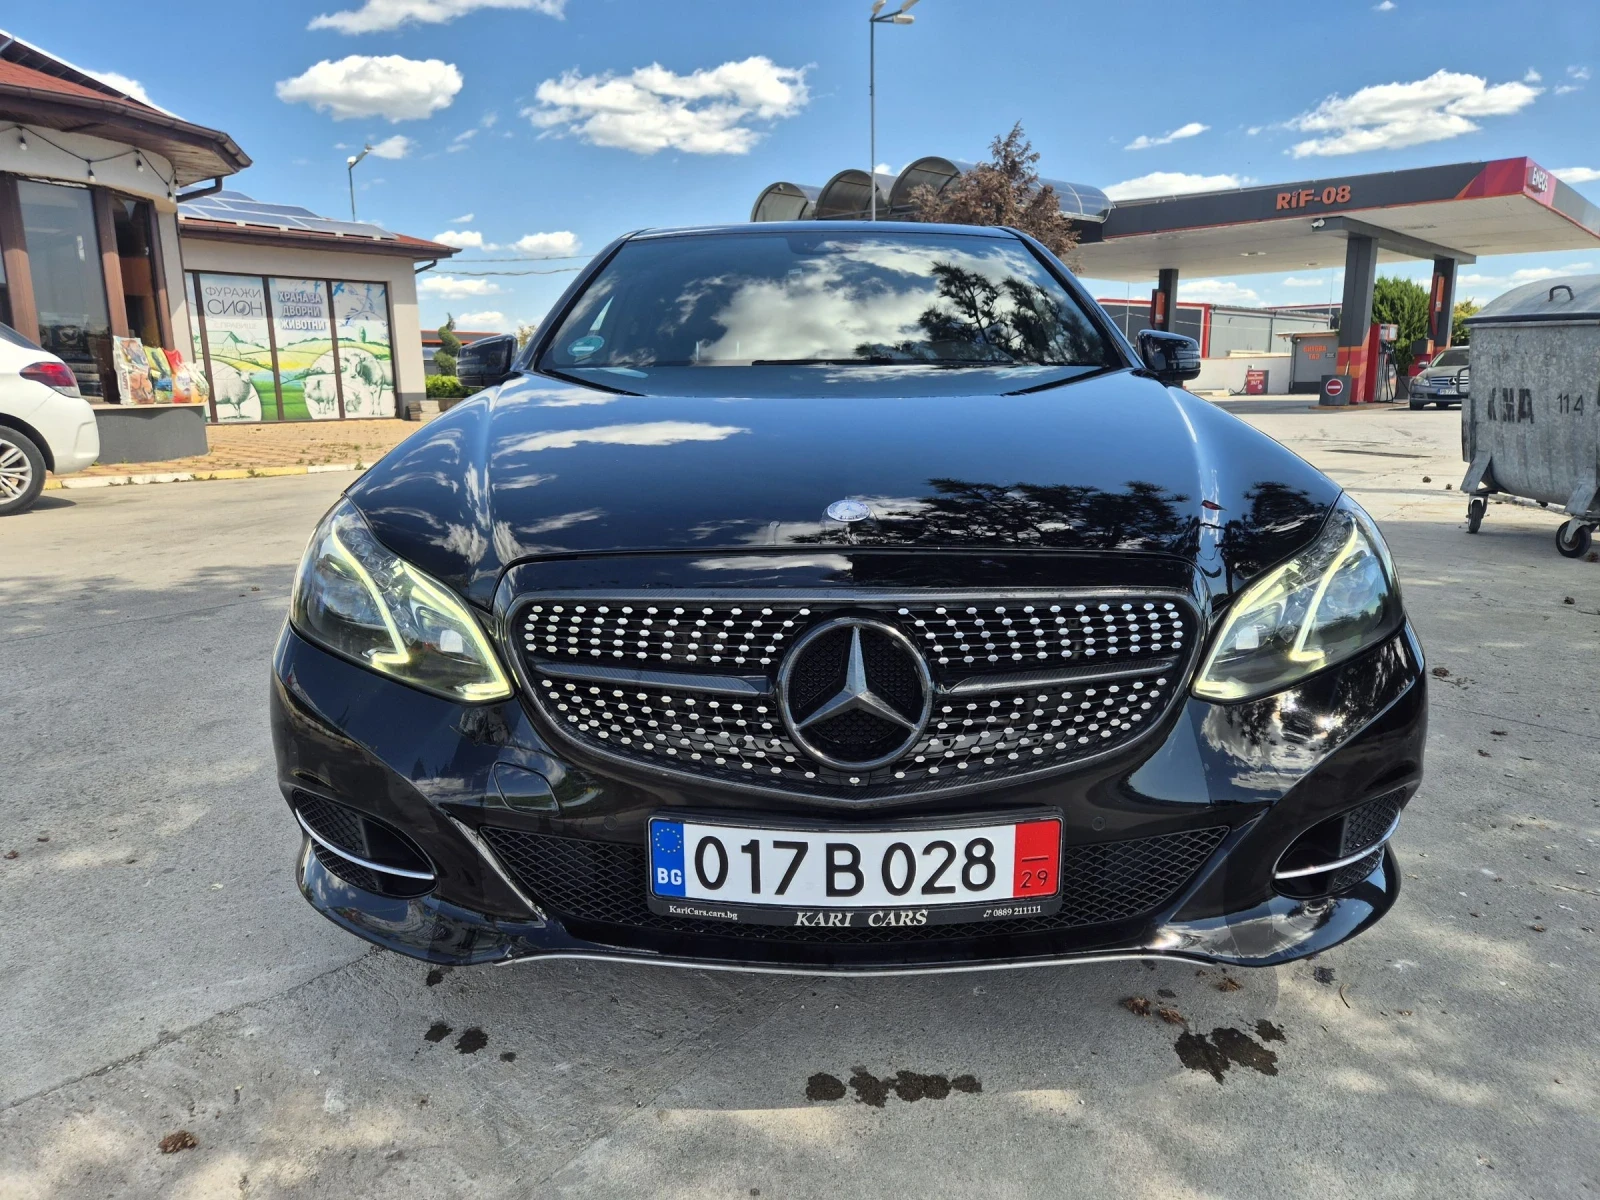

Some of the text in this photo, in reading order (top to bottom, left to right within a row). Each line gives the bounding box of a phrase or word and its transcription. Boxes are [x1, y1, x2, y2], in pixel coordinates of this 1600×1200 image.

[205, 286, 261, 298] ФУРАЖИ
[278, 291, 322, 304] ХРАНА ЗА
[207, 299, 263, 316] СИОН
[282, 305, 321, 317] ДВОРНИ
[281, 319, 325, 330] ЖИВОТНИ
[1557, 393, 1584, 416] 114
[695, 835, 996, 897] 017 B 028
[657, 867, 683, 886] BG
[1020, 868, 1048, 889] 29
[669, 905, 738, 921] KariCars.cars.bg
[794, 909, 929, 927] KARI CARS
[993, 905, 1042, 917] 0889 211111
